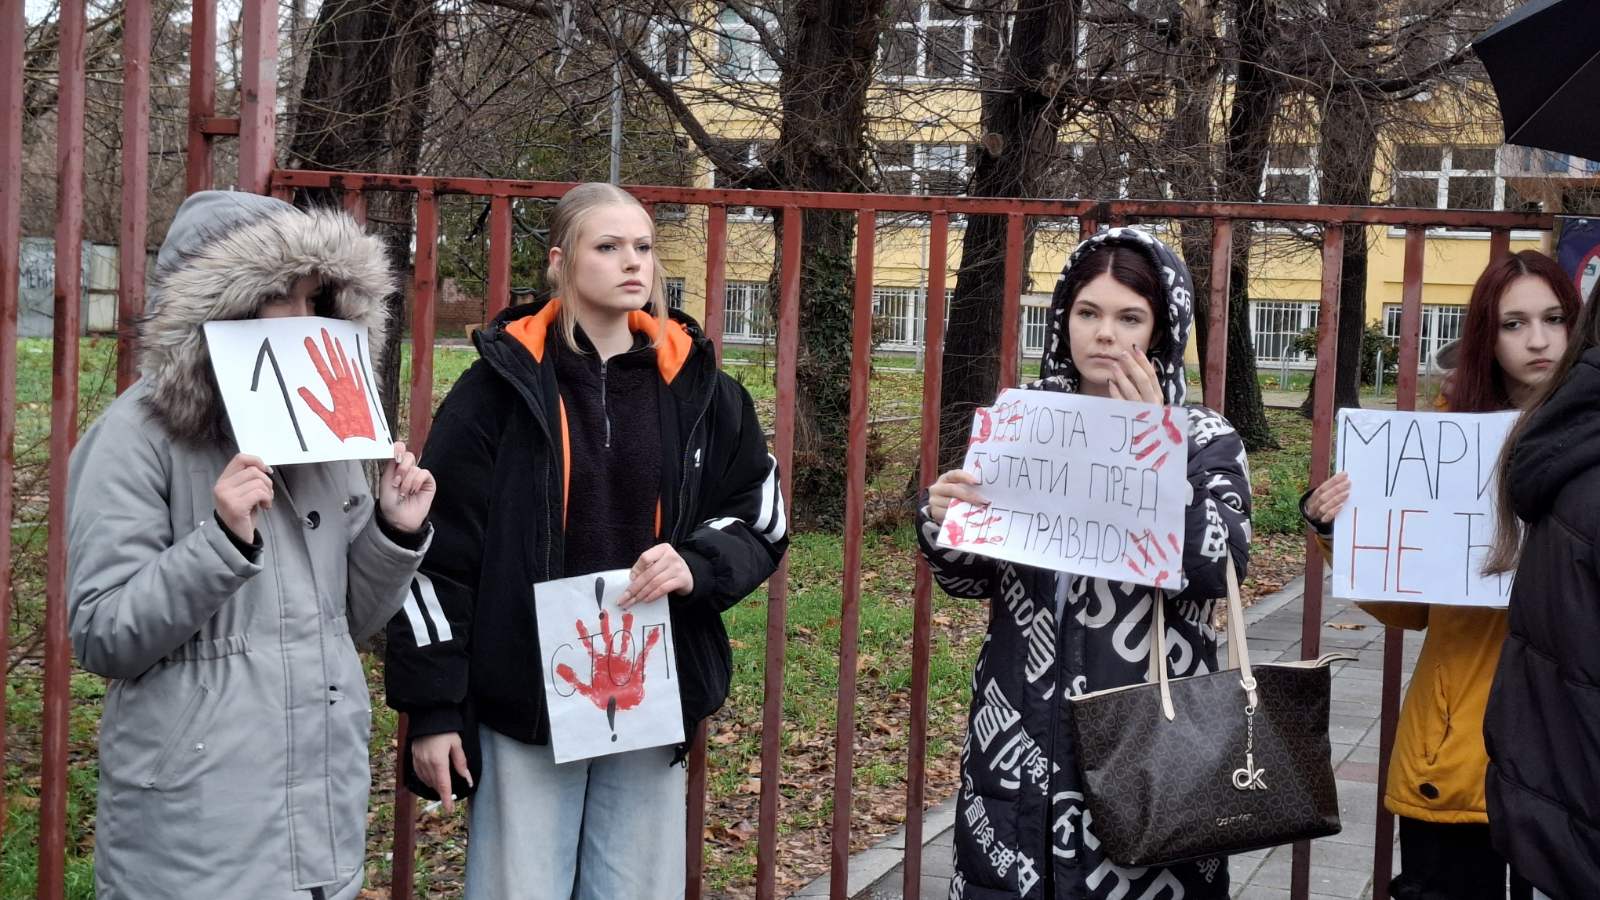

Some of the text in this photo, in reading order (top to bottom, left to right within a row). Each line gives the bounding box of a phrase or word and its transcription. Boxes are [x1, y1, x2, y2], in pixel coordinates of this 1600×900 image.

[1089, 462, 1160, 523] ПРЕД
[1342, 415, 1501, 500] МАРИ
[962, 503, 1150, 569] НЕПРАВДОМ
[1351, 506, 1429, 595] НЕ
[551, 623, 671, 698] СТОП
